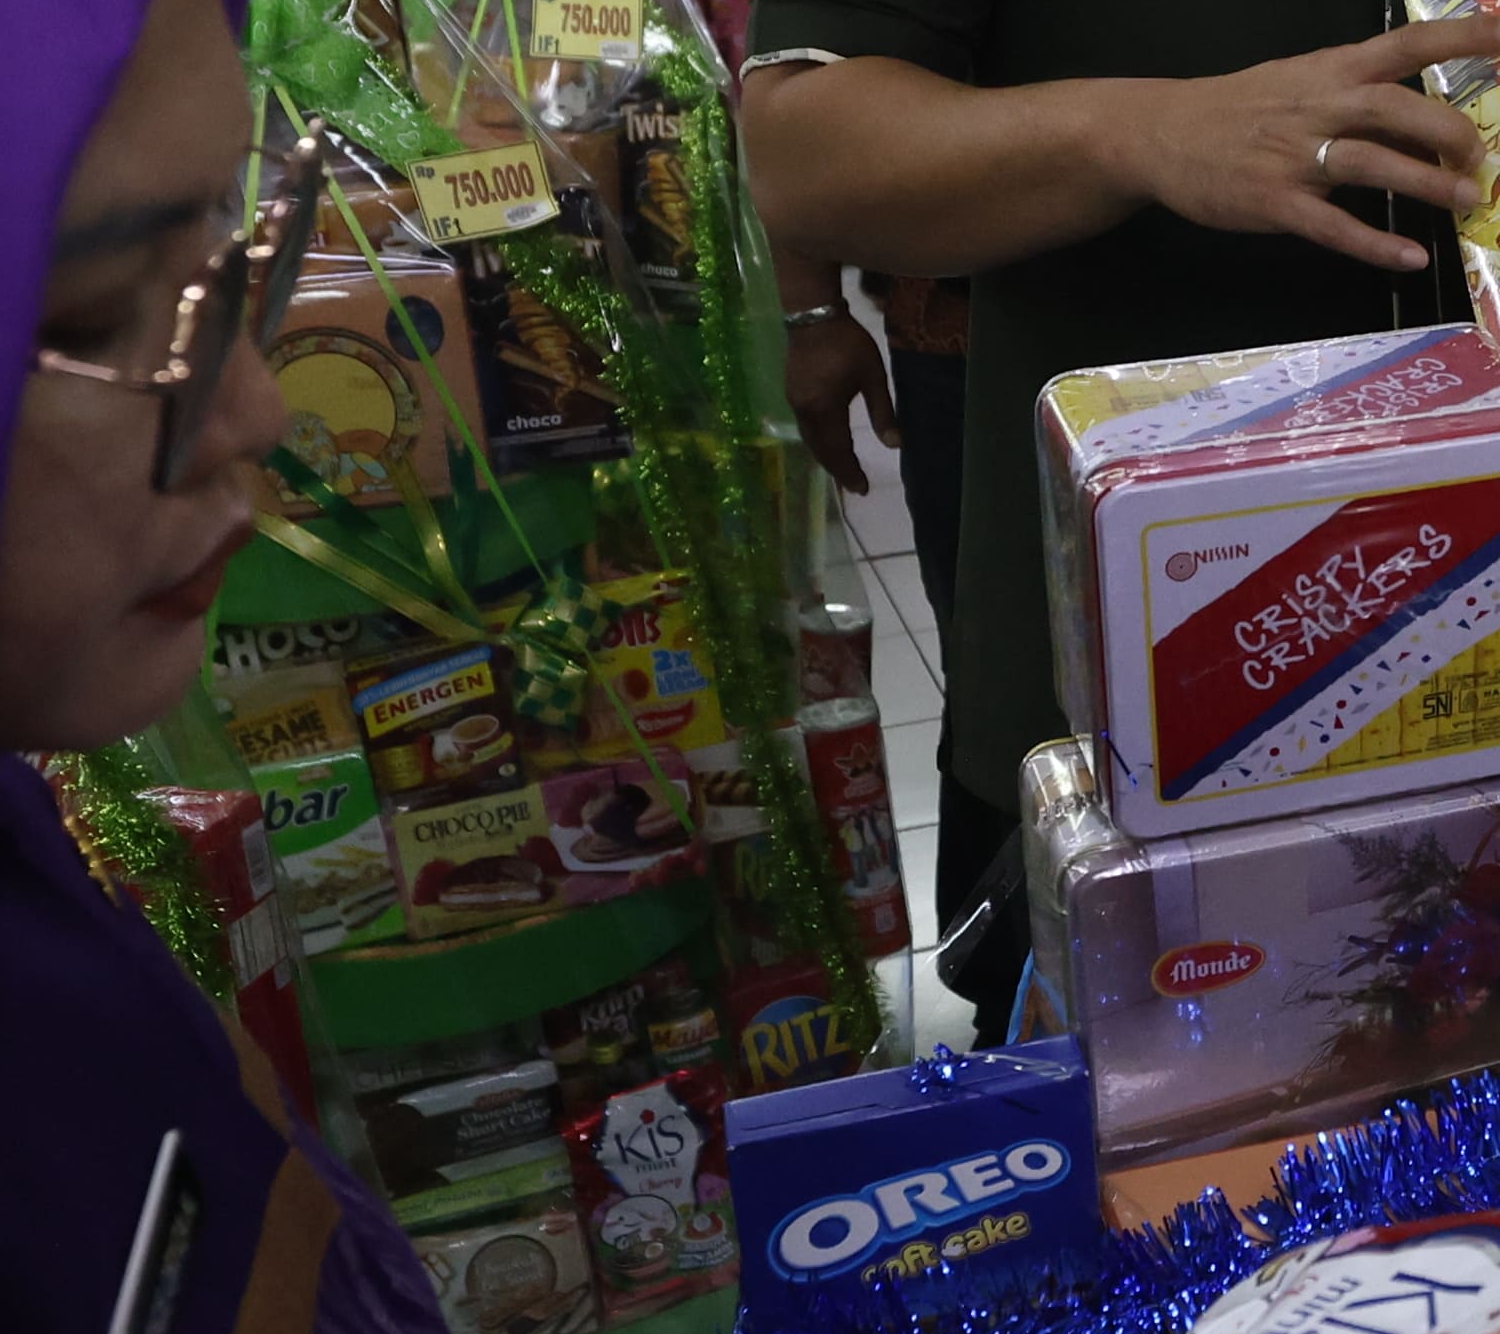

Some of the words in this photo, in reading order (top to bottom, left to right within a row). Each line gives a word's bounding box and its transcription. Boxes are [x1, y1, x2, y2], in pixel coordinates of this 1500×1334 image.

[560, 3, 632, 37] 750.000
[445, 161, 535, 209] 750.000
[506, 410, 562, 431] choco
[1194, 542, 1250, 566] NISSIN
[1233, 543, 1366, 654] CRISPY
[1241, 523, 1452, 692] CRACKERS
[600, 610, 661, 649] olls
[373, 671, 485, 725] ENERGEN
[1169, 949, 1252, 986] Monde
[741, 1004, 857, 1088] RITZ
[613, 1115, 685, 1166] KIS
[775, 1139, 1065, 1271] OREO
